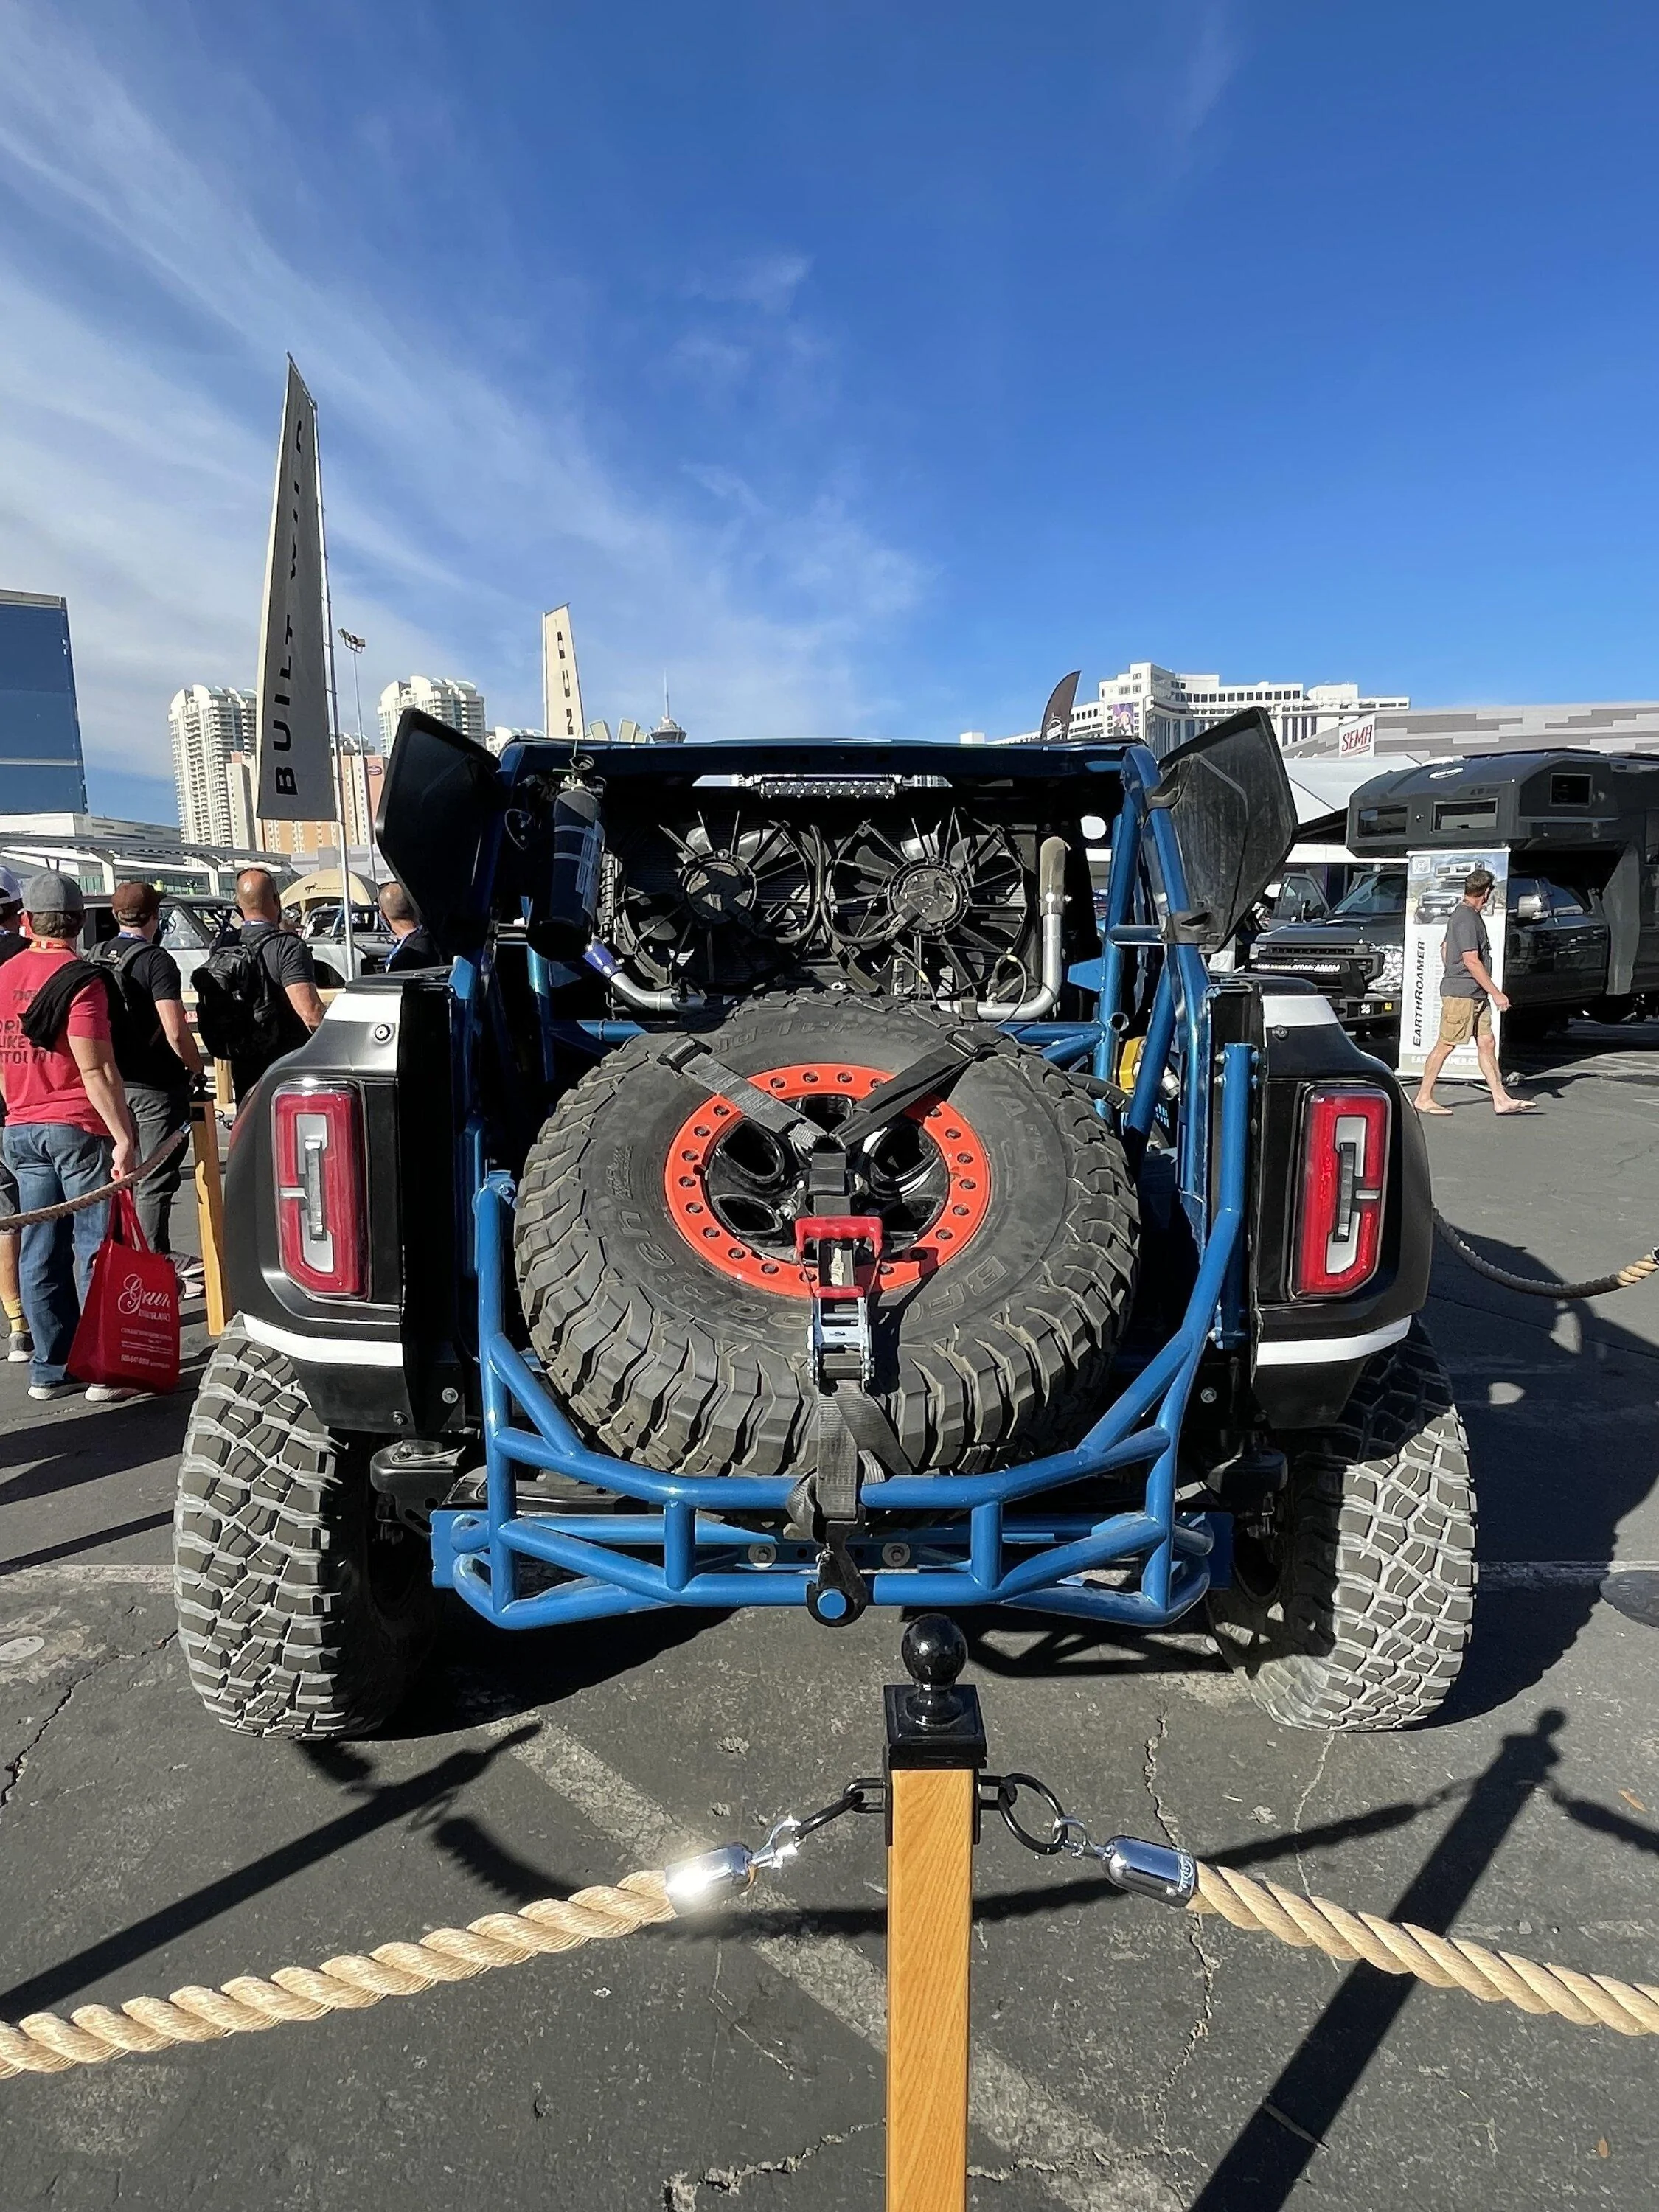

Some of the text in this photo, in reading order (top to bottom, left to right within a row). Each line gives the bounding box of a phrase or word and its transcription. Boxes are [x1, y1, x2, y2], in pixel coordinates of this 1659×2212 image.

[274, 614, 299, 796] BUILT
[1342, 724, 1373, 751] SEMA
[1413, 941, 1425, 1048] EARTHROAMER
[618, 1210, 1010, 1329] BFGodrich
